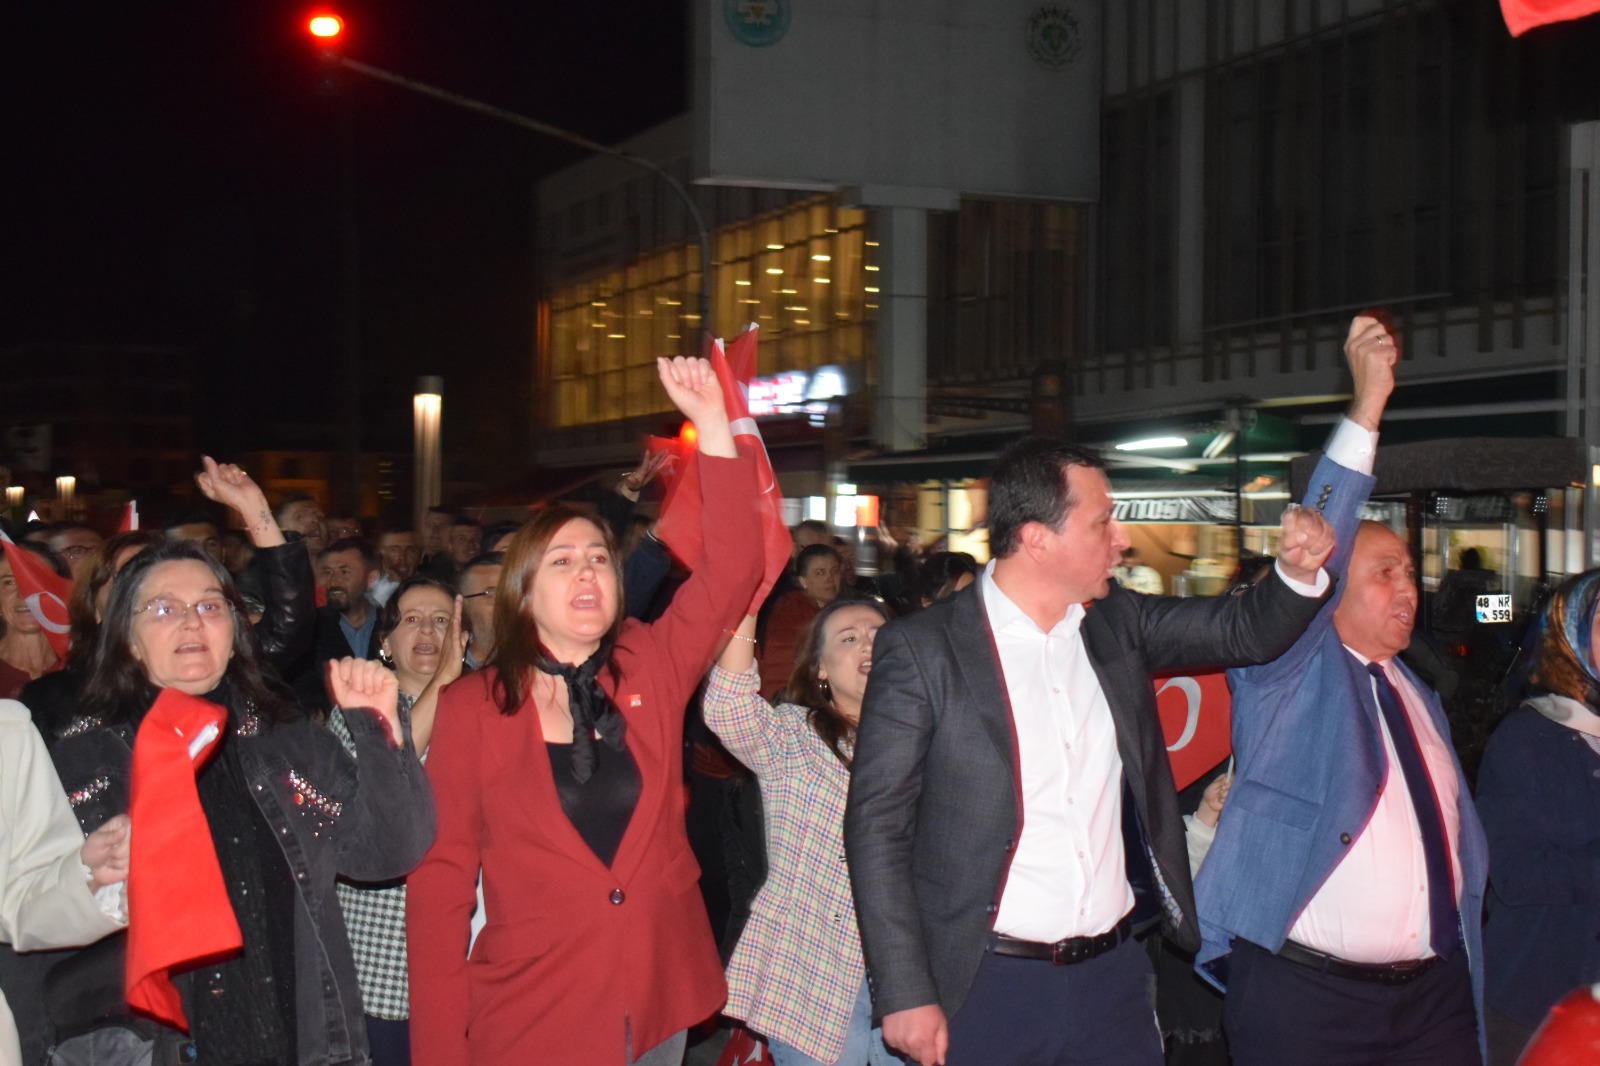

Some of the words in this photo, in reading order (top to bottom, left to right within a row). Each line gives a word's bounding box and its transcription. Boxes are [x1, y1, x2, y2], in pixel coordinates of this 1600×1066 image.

[1477, 597, 1490, 608] 48
[1498, 596, 1510, 608] NR
[1492, 609, 1510, 621] 559
